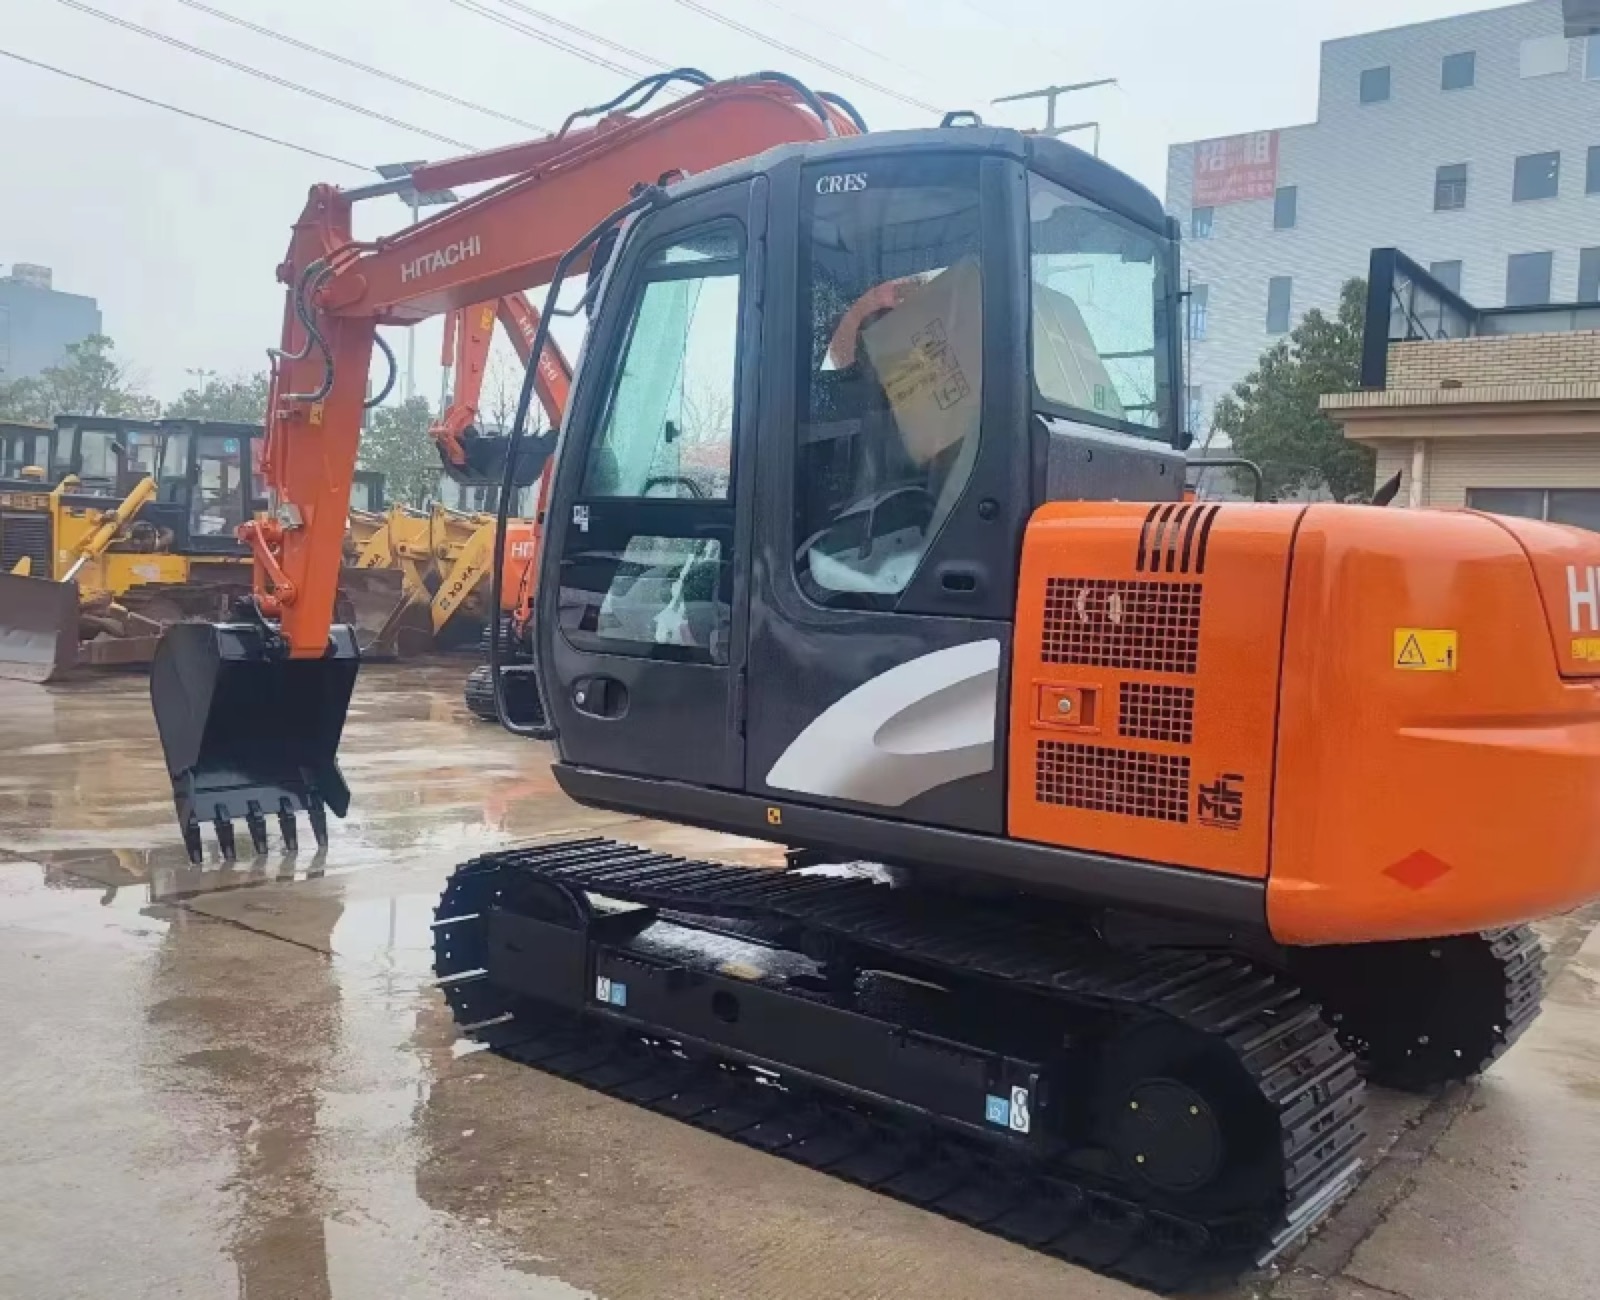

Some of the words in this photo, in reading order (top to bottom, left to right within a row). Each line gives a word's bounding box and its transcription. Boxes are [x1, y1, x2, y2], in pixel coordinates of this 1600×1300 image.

[816, 172, 868, 194] CRES
[401, 234, 481, 283] HITACHI
[519, 315, 559, 382] HICHI
